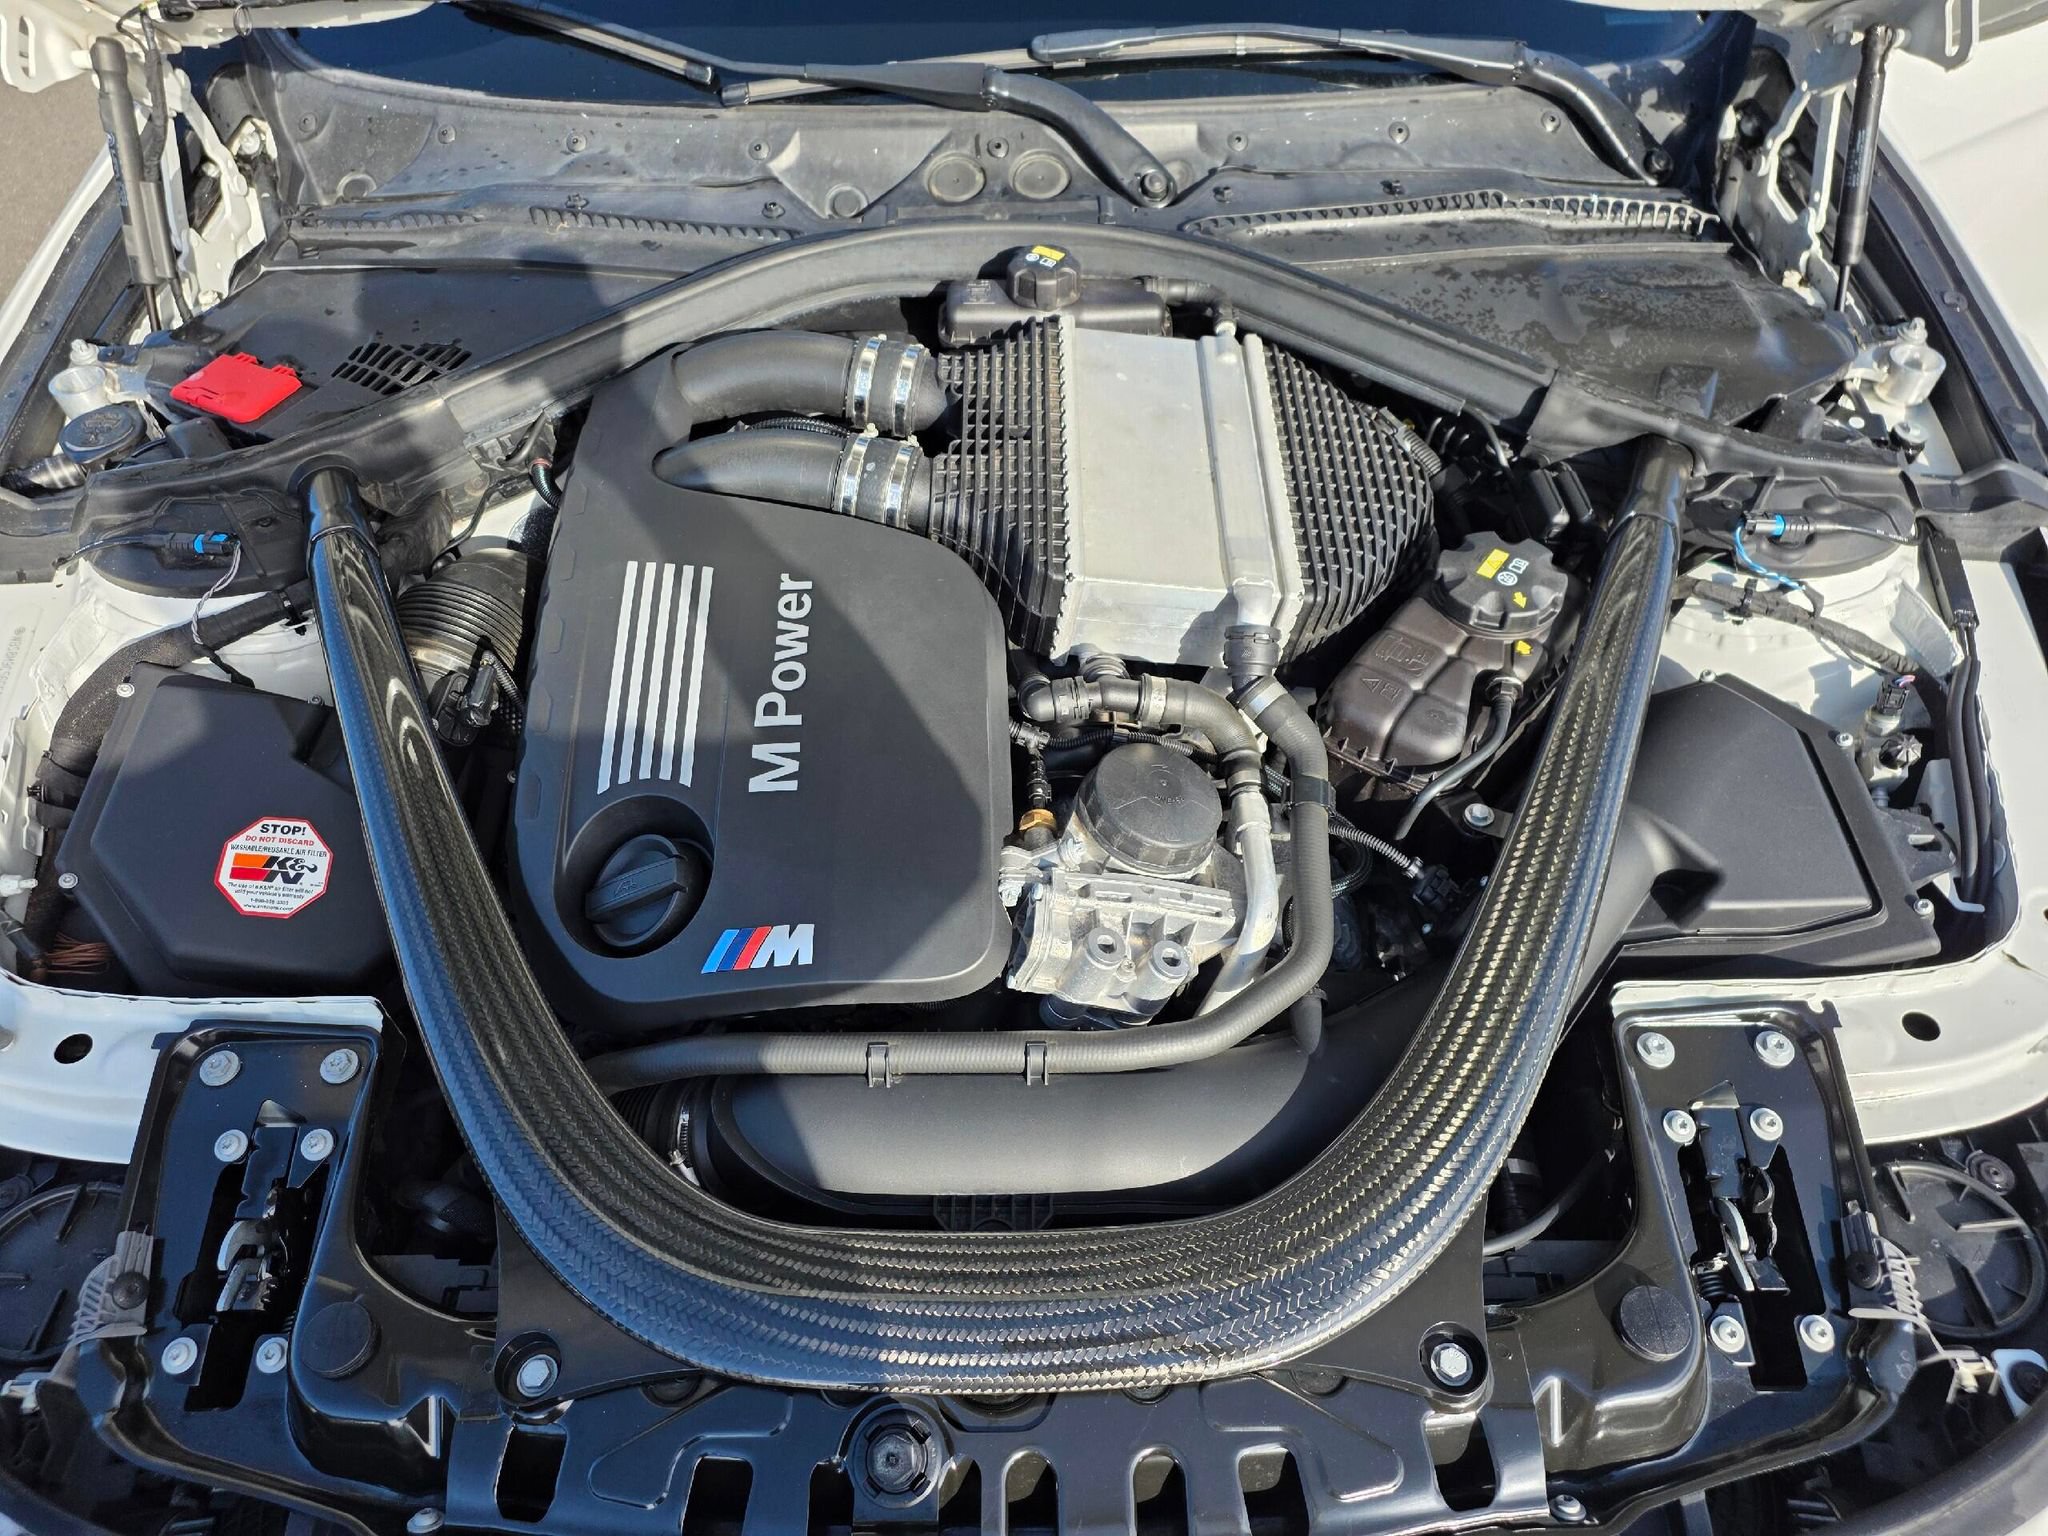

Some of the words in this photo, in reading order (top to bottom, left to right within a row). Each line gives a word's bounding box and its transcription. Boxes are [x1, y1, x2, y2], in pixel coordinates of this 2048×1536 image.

[753, 572, 813, 727] Power
[748, 742, 801, 793] M
[260, 823, 307, 836] STOP!
[278, 837, 315, 847] DISCARD
[294, 848, 306, 856] AIR
